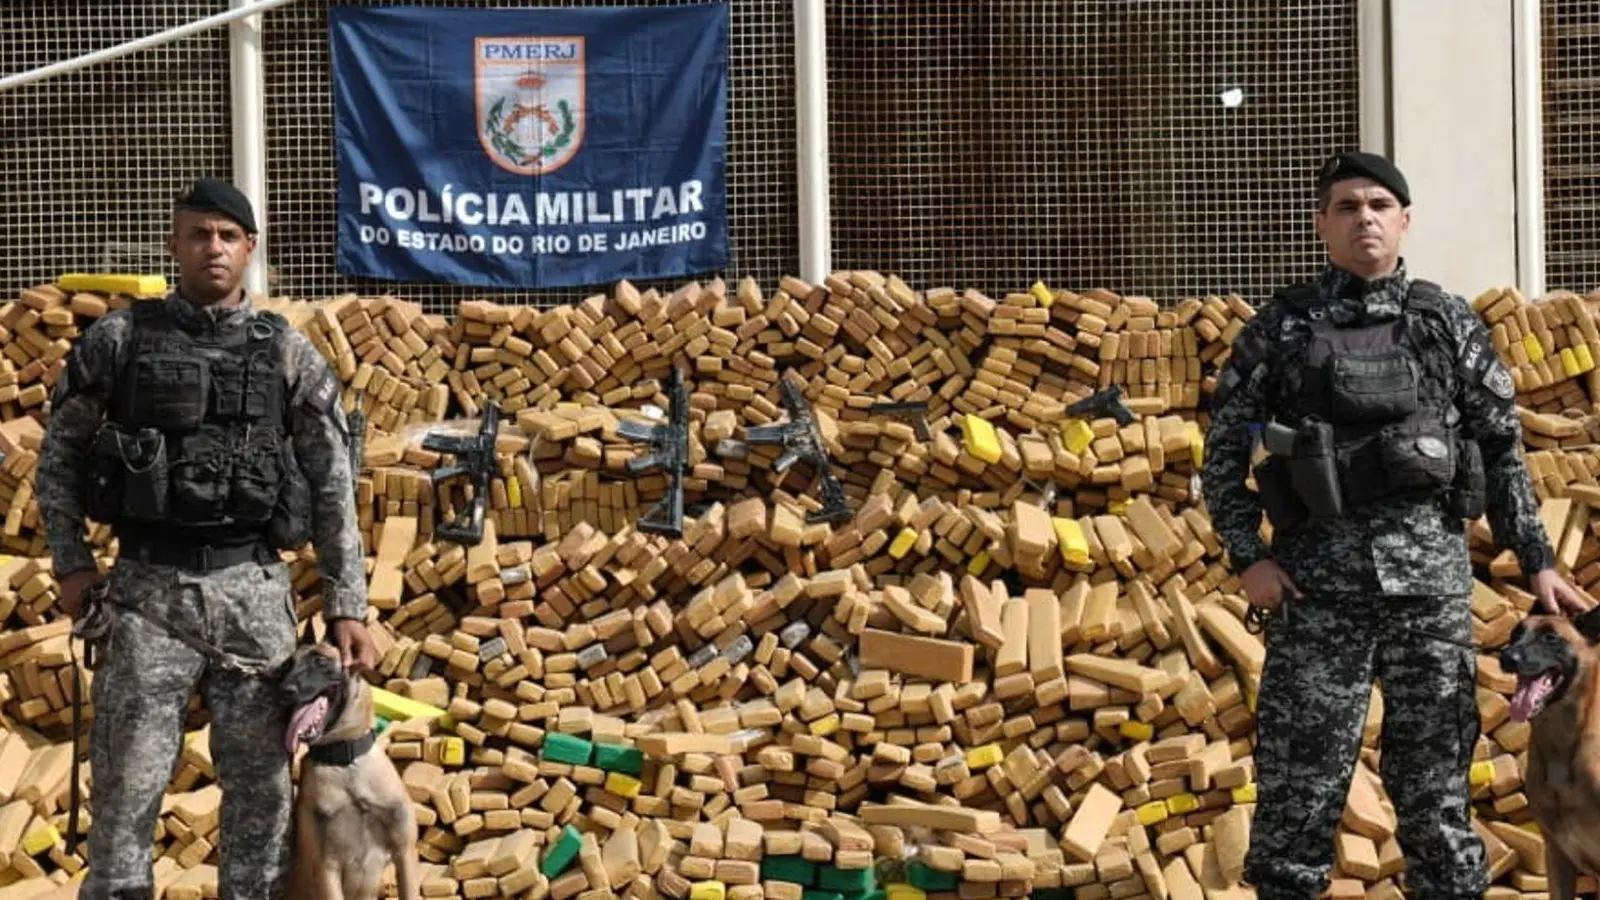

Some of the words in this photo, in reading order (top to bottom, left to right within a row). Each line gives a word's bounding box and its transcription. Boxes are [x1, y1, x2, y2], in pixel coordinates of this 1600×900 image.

[485, 44, 576, 59] PMERJ
[359, 182, 529, 226] POLÍCIA
[537, 179, 704, 225] MILITAR
[360, 226, 389, 246] DO
[397, 229, 485, 254] ESTADO
[493, 231, 524, 254] DO
[532, 231, 571, 254] RIO
[578, 230, 607, 253] DE
[614, 221, 706, 251] JANEIRO
